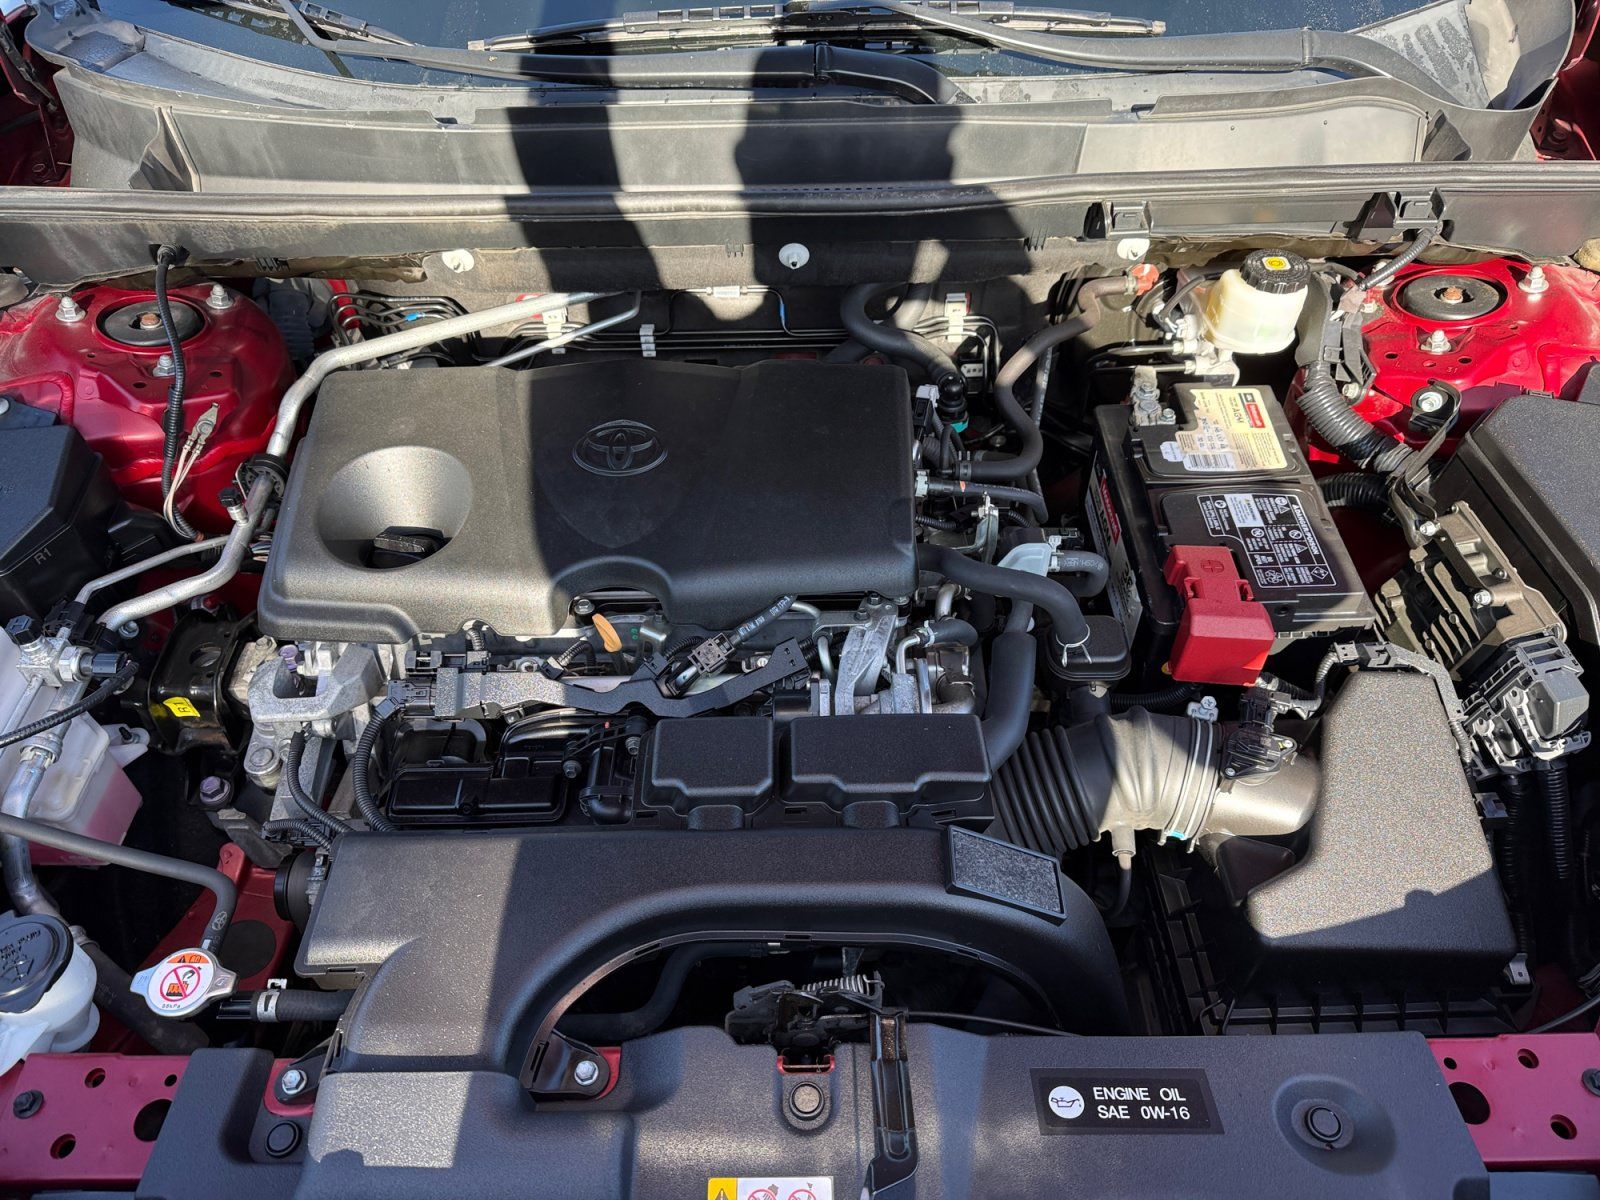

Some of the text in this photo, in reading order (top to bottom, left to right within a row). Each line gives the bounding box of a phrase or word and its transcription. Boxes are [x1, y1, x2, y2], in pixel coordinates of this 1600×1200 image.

[1294, 509, 1319, 554] DANGER/POISON
[34, 548, 51, 564] R1
[1093, 1087, 1186, 1101] ENGINE OIL
[1097, 1105, 1190, 1119] SAE 0W-16
